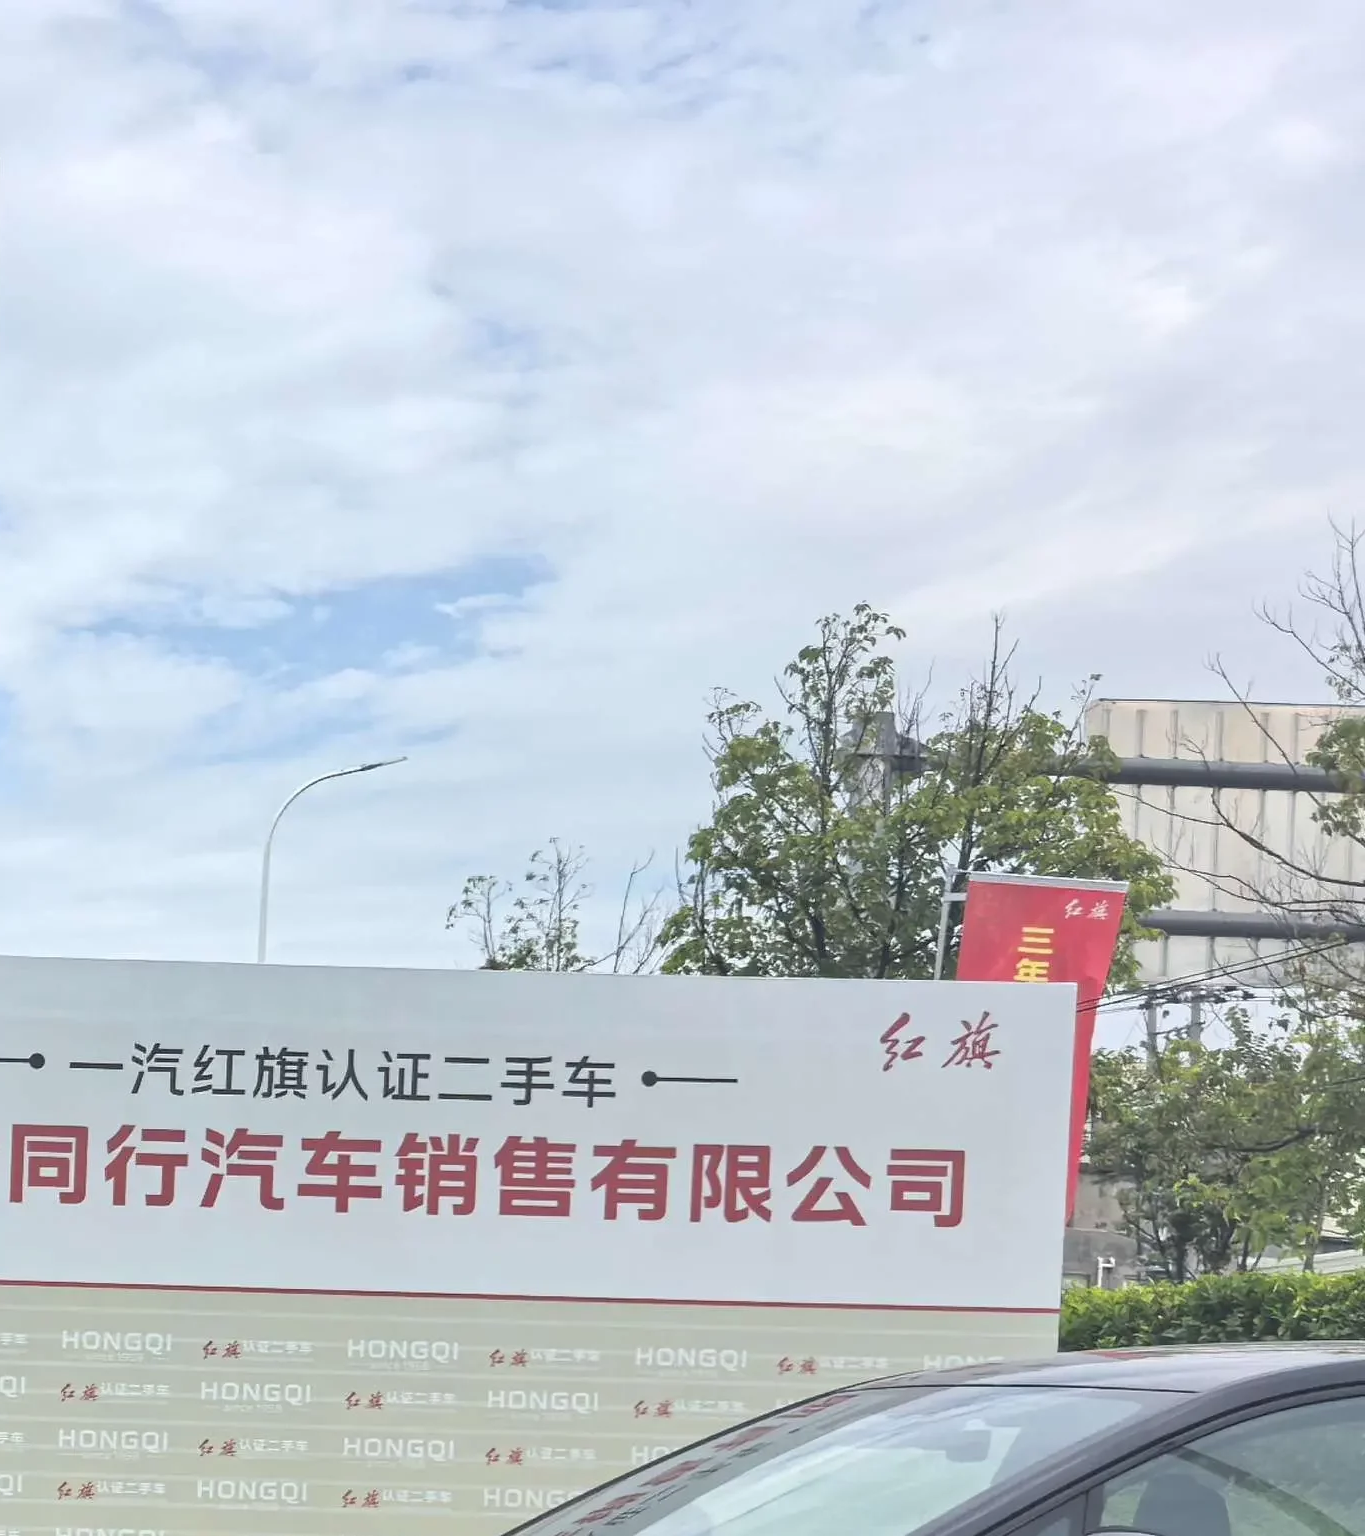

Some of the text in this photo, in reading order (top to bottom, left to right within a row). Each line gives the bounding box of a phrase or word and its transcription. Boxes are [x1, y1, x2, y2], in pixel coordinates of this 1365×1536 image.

[1065, 899, 1110, 920] 红旗
[879, 1011, 1002, 1072] 红旗
[69, 1043, 617, 1108] 一汽红旗认证二手车
[61, 1330, 173, 1355] HONGQI
[347, 1339, 459, 1363] HONGQI
[635, 1347, 748, 1371] HONGQI
[200, 1381, 313, 1406] HONGQI
[486, 1390, 600, 1413] HONGQI
[58, 1429, 169, 1453] HONGQI
[343, 1437, 455, 1462] HONGQI
[196, 1479, 308, 1504] HONGQI
